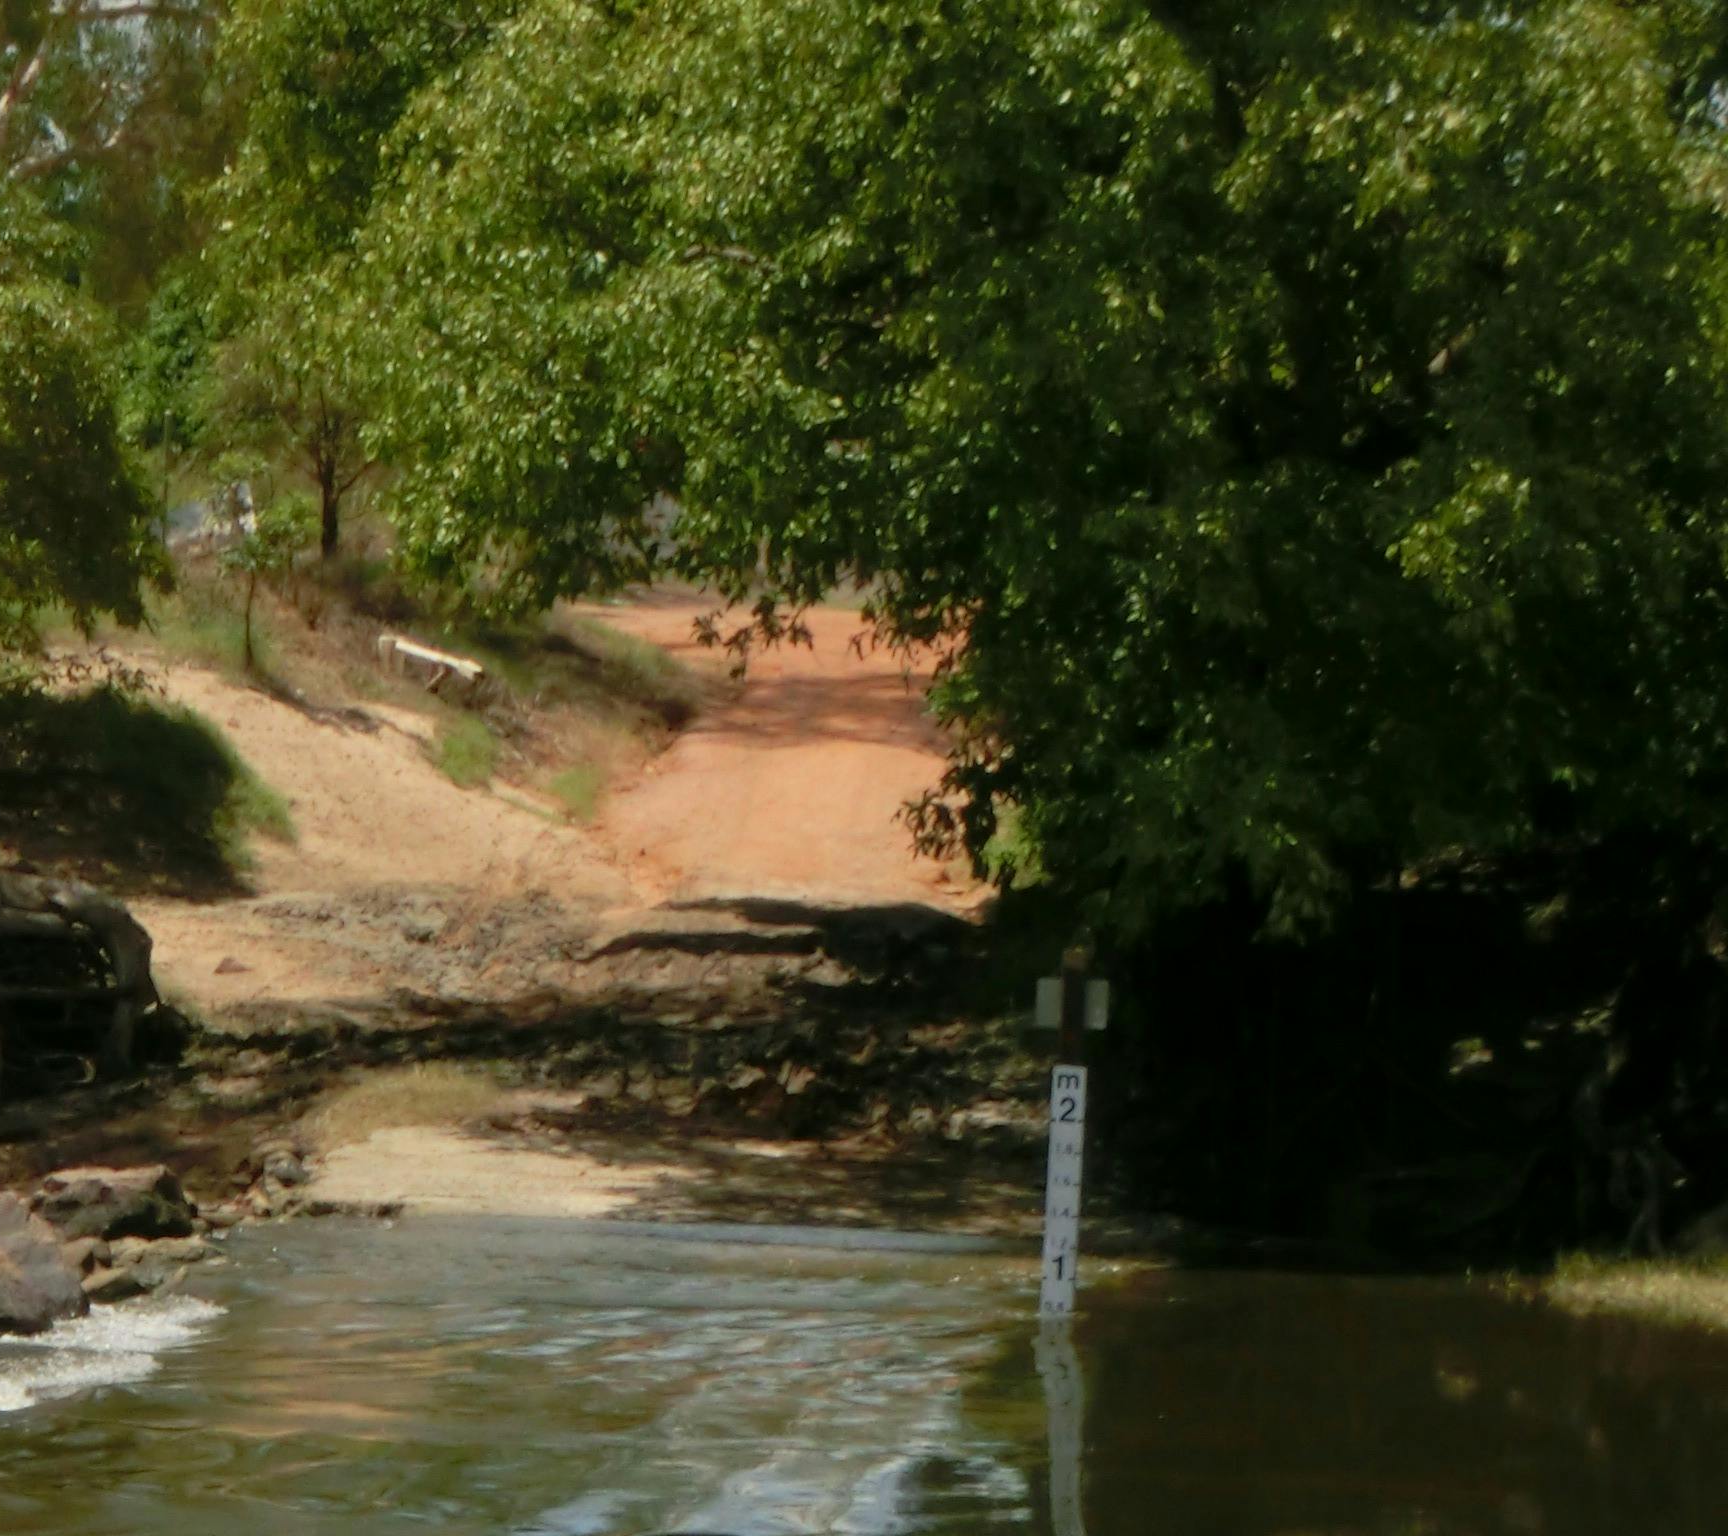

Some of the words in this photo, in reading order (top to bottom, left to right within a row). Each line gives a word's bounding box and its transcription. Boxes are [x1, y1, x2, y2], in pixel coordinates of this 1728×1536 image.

[1056, 1073, 1080, 1090] m
[1059, 1096, 1076, 1123] 2
[1051, 1255, 1065, 1281] 1
